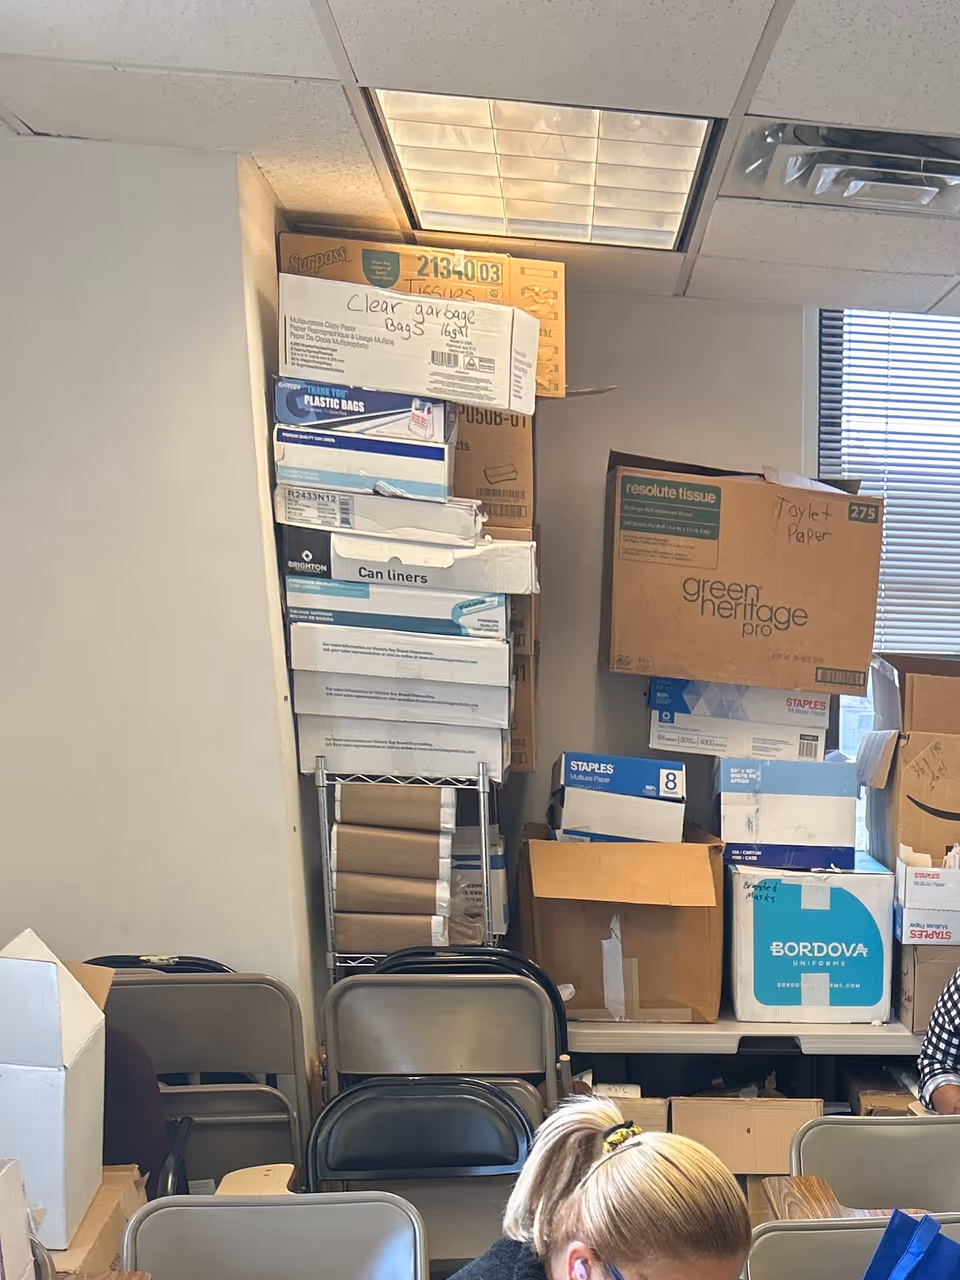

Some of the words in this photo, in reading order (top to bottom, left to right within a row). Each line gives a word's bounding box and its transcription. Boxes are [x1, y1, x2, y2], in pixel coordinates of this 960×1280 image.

[289, 246, 348, 274] Surpass
[480, 263, 500, 282] 03
[347, 293, 403, 314] Clear
[413, 303, 476, 328] garbage
[384, 317, 425, 340] Bags
[303, 395, 340, 409] PLASTIC
[341, 399, 365, 413] BAGS
[626, 483, 678, 499] resolute
[679, 487, 717, 504] tissue
[850, 505, 876, 520] 275
[787, 523, 833, 547] Paper
[288, 560, 327, 572] BRIGHTON
[358, 566, 383, 580] Can
[387, 569, 429, 584] liners
[682, 576, 761, 603] green
[700, 597, 809, 631] heritage
[742, 621, 773, 638] pro
[785, 697, 827, 711] STAPLES
[570, 760, 614, 775] STAPLES
[665, 771, 678, 791] 8
[914, 872, 941, 880] STAPLES
[909, 929, 952, 940] STAPLES
[770, 941, 869, 958] BORDOVA
